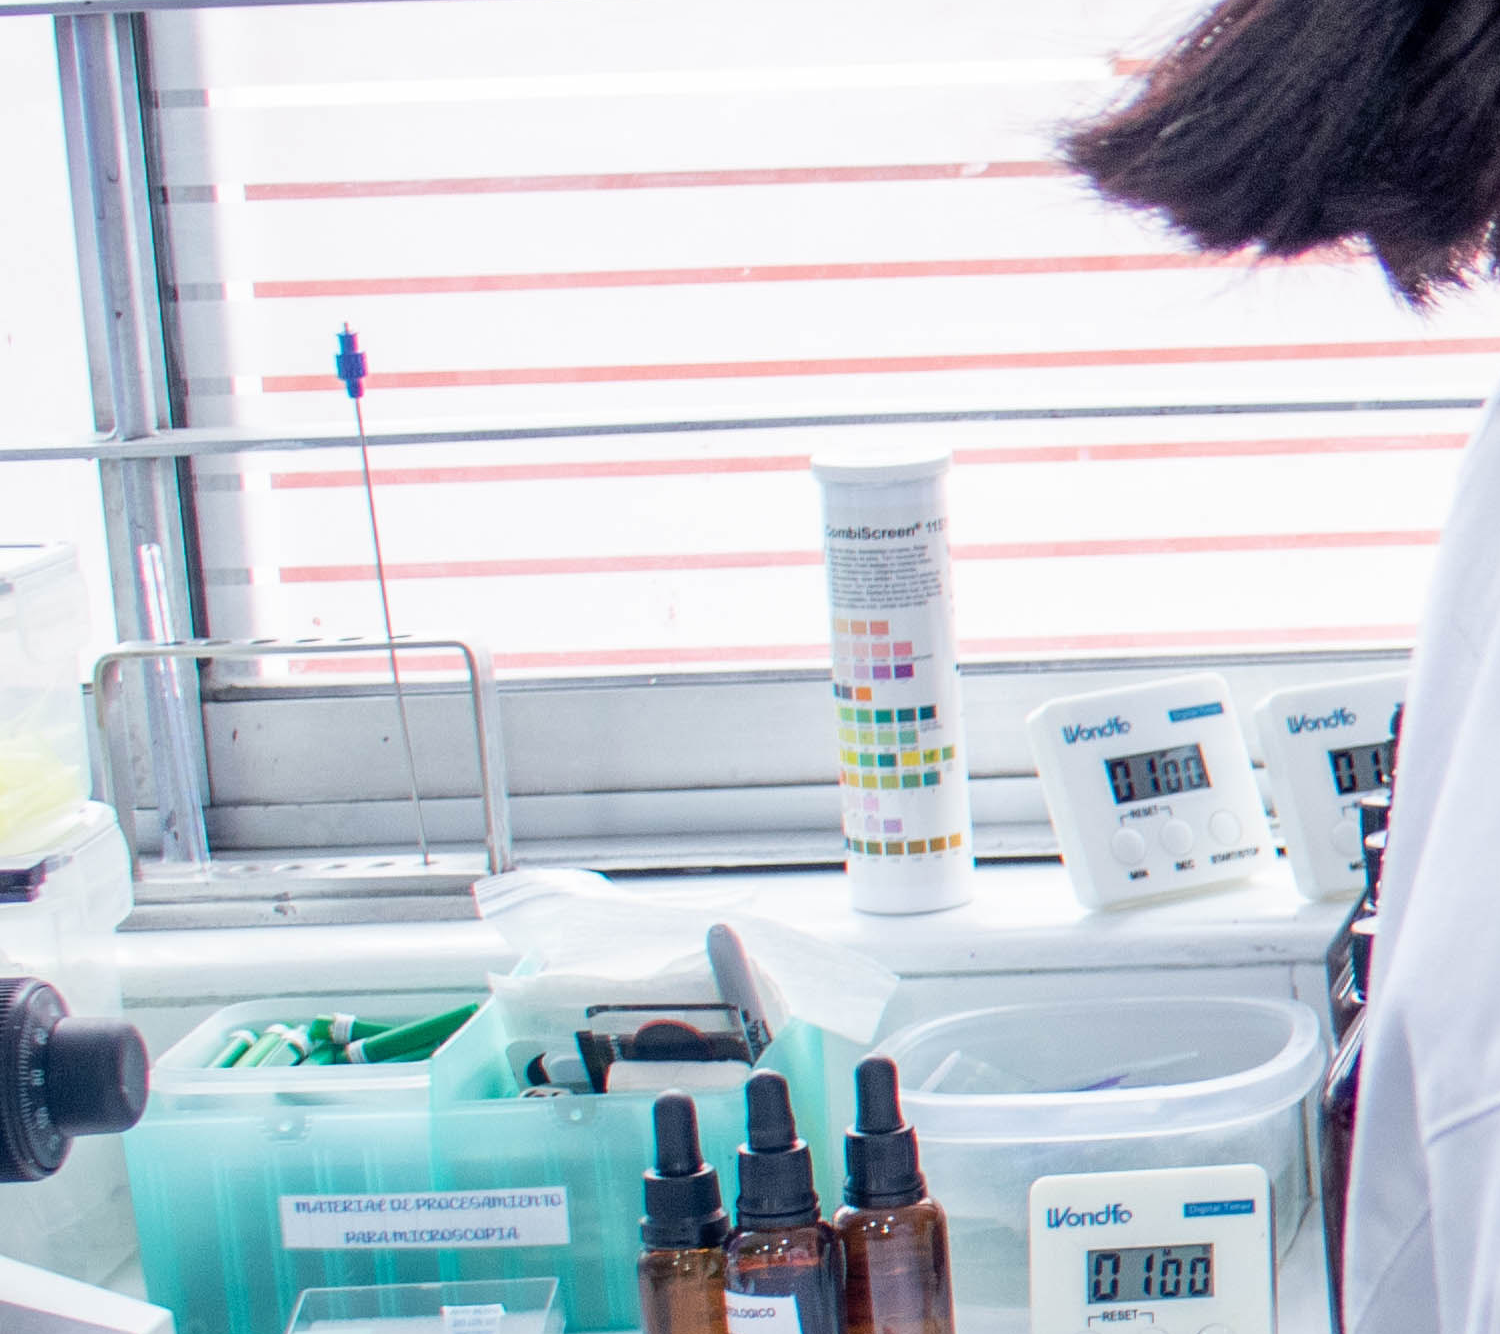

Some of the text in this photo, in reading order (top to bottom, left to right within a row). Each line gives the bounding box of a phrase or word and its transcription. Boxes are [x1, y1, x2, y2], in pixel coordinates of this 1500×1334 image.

[1062, 716, 1131, 744] Wondfo
[1287, 707, 1356, 734] Wondfo
[390, 1197, 414, 1211] DE
[416, 1193, 561, 1210] PROCESAMIENTO
[1047, 1203, 1132, 1228] Wondfo
[344, 1226, 520, 1244] PARA MICROSCOPIA
[1102, 1310, 1138, 1322] RESET
